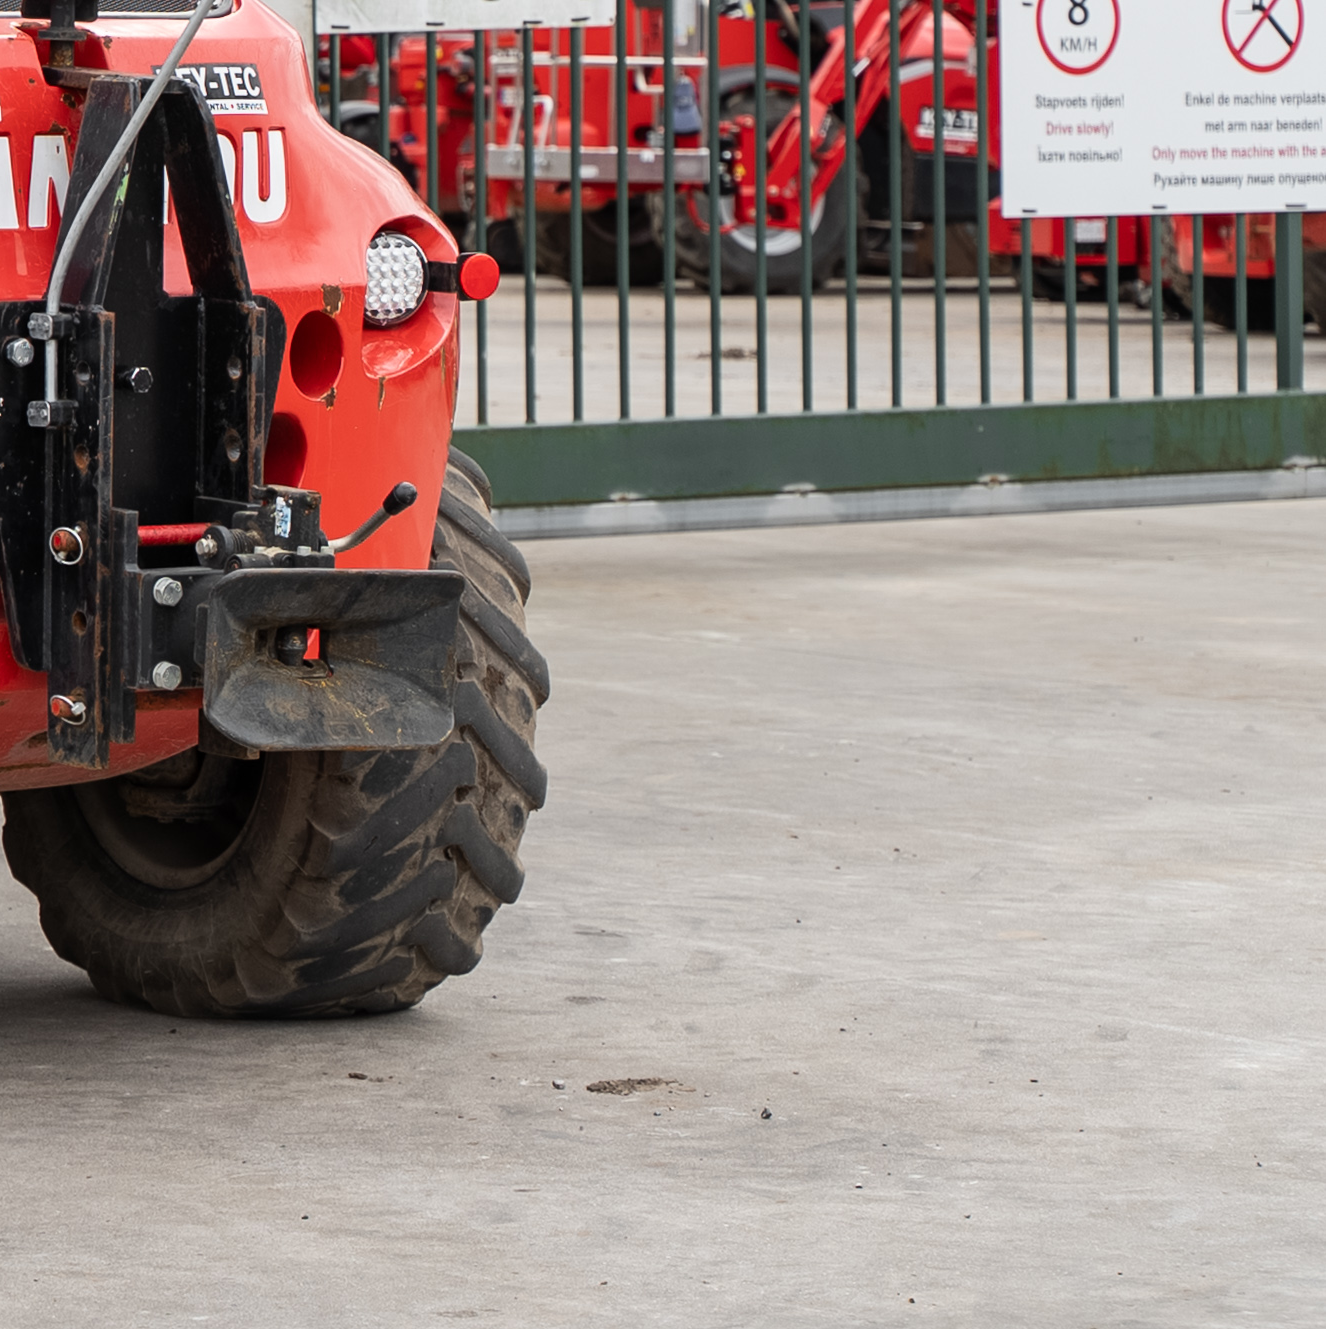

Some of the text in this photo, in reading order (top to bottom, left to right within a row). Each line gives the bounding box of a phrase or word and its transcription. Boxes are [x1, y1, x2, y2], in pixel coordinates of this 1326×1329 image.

[1060, 36, 1098, 52] KM/H
[1035, 93, 1125, 112] Stapvoets rijden!
[1185, 91, 1214, 107] Enkel
[1218, 92, 1230, 106] de
[1233, 91, 1277, 106] machine
[1046, 120, 1114, 139] Drive slowly!
[1205, 118, 1323, 133] met arm naar beneden!
[1152, 145, 1176, 164] Only
[1179, 147, 1208, 160] move
[1211, 145, 1228, 160] the
[1231, 145, 1275, 160] machine
[1278, 144, 1299, 158] with
[1302, 144, 1318, 158] the
